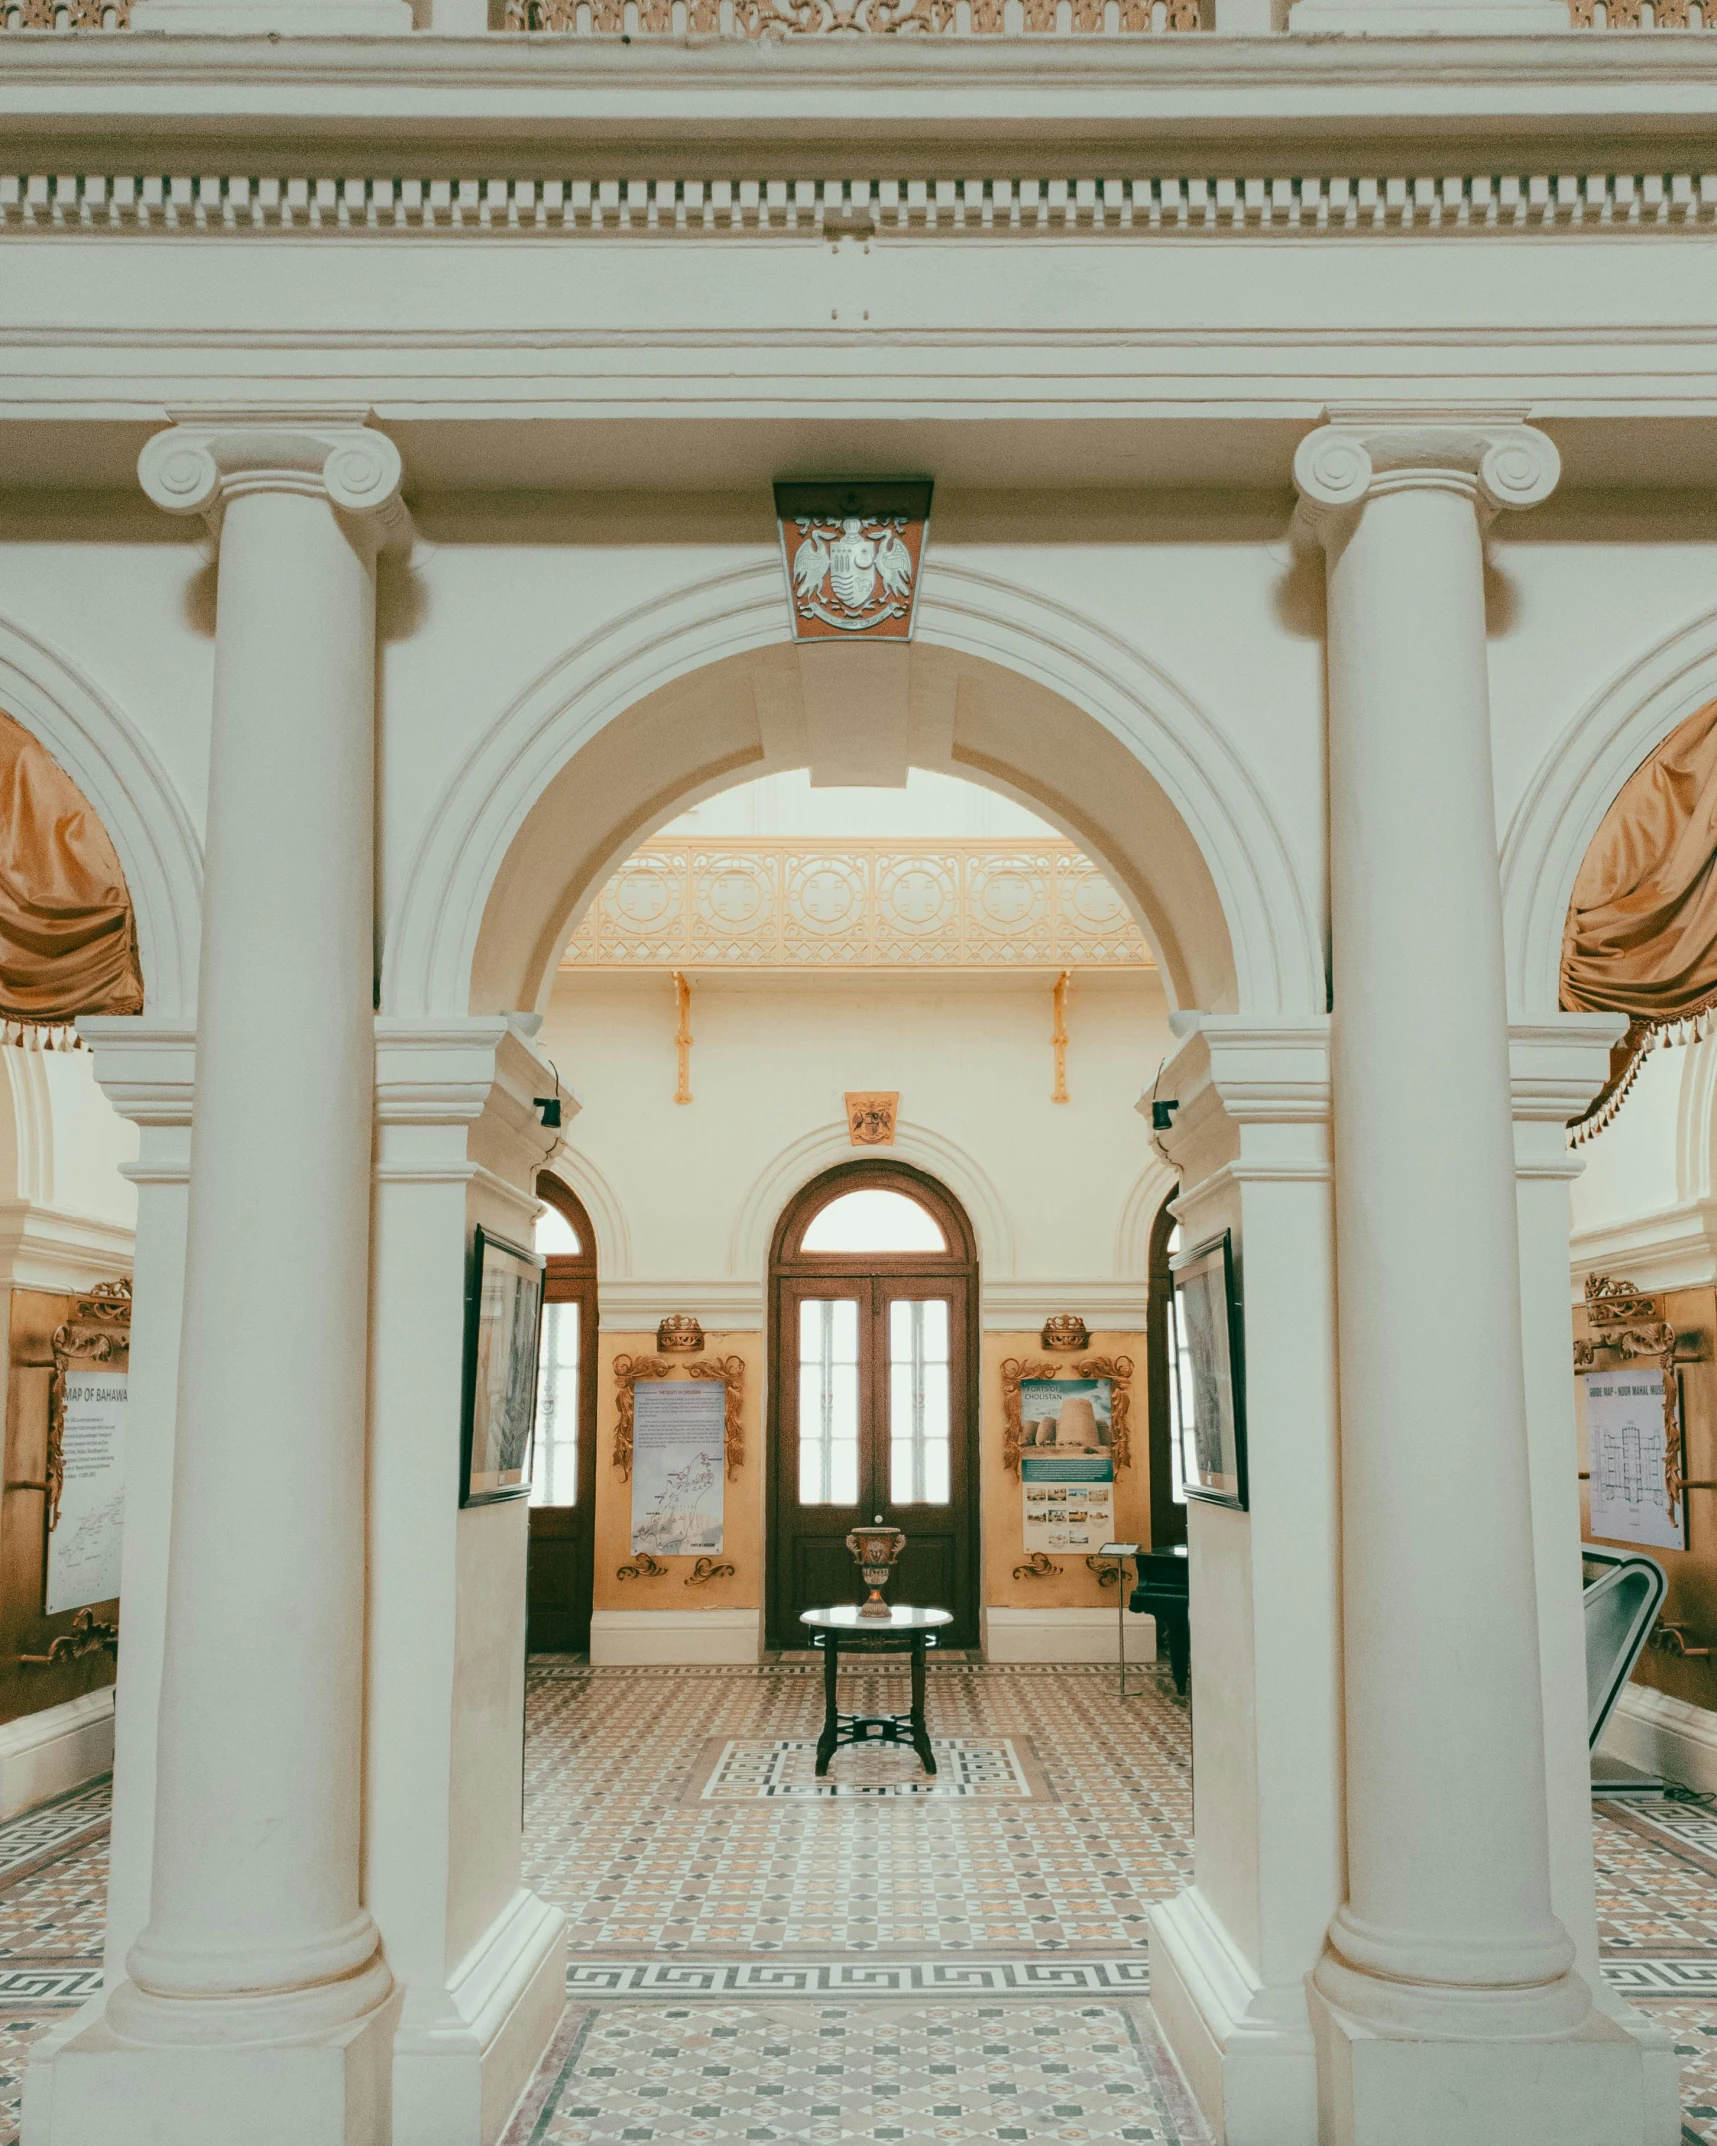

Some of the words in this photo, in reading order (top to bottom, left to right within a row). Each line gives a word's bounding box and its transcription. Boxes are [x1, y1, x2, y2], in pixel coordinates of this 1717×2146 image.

[1027, 1385, 1049, 1393] FORTS
[1050, 1385, 1059, 1393] OF
[65, 1388, 83, 1401] MAP
[84, 1388, 95, 1401] OF
